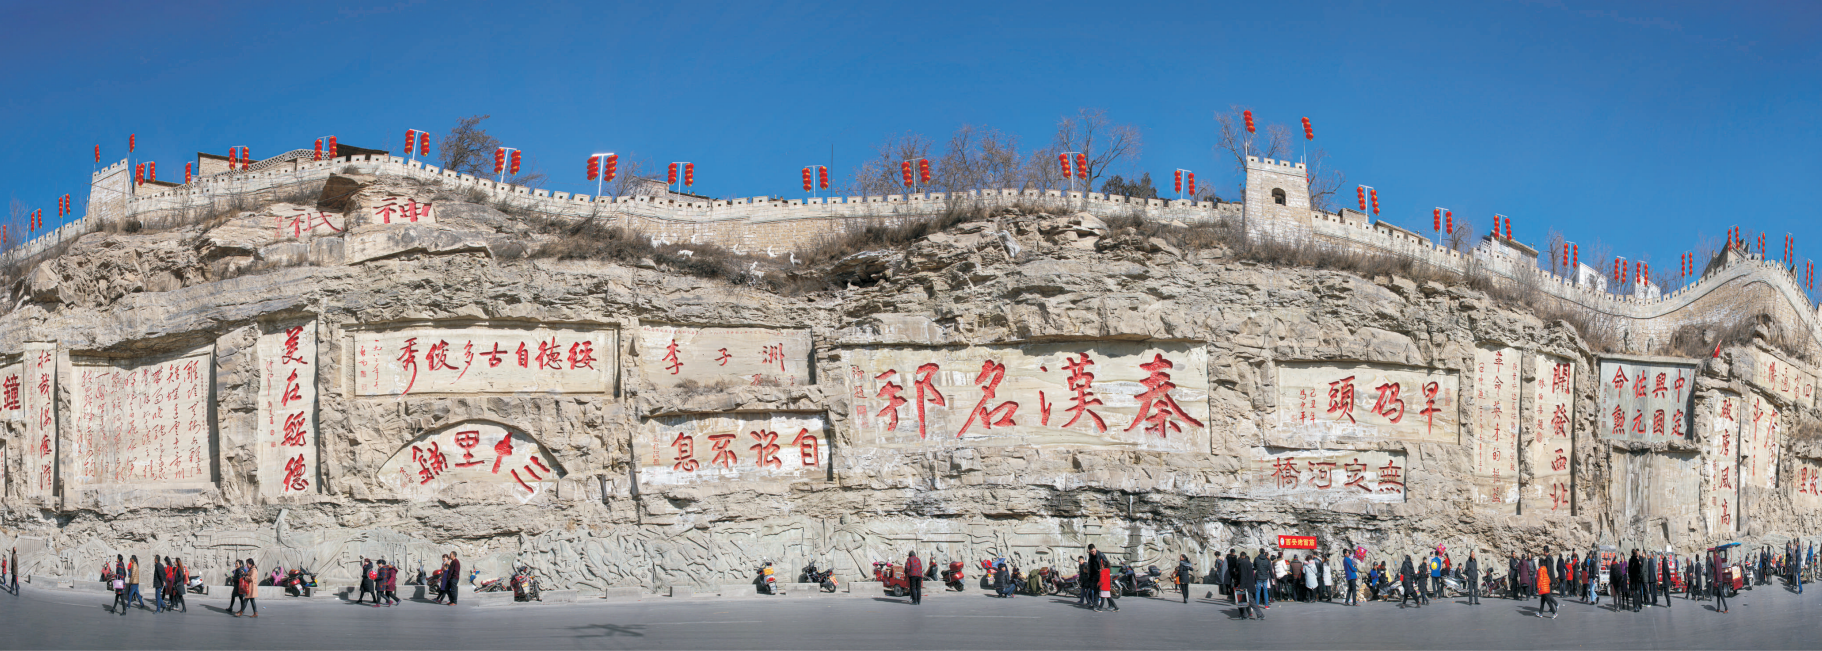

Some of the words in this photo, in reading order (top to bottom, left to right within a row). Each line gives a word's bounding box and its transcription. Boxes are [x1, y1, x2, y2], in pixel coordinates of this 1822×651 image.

[875, 352, 1205, 440] 秦漢名邦
[1550, 362, 1570, 510] 開發西北
